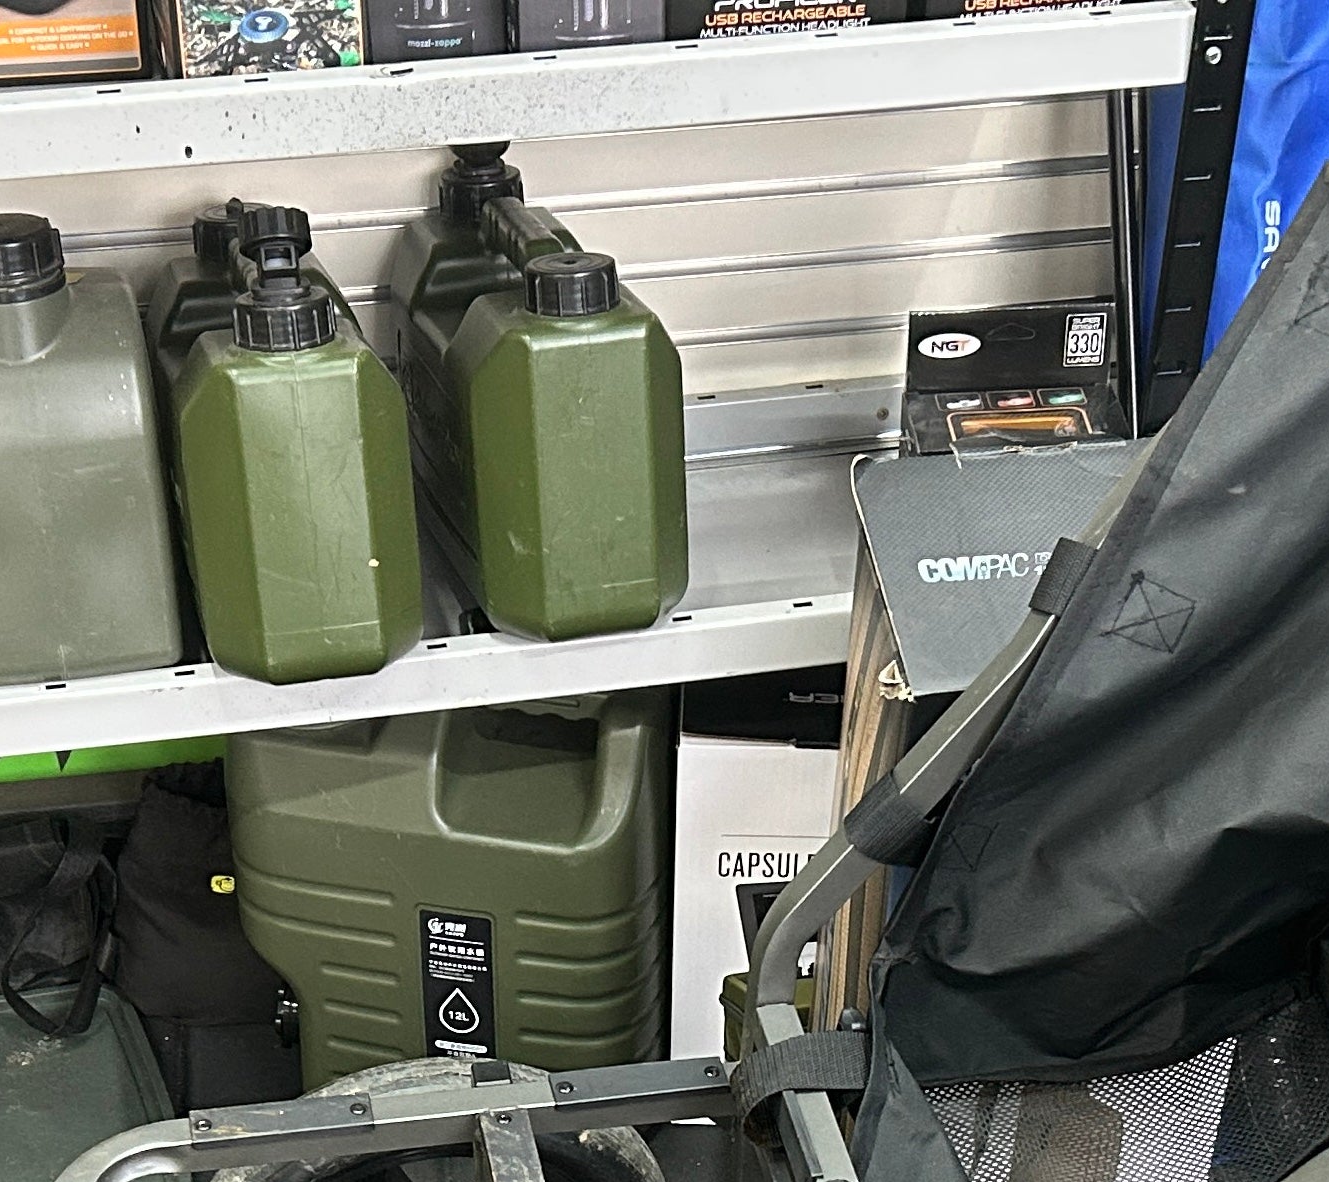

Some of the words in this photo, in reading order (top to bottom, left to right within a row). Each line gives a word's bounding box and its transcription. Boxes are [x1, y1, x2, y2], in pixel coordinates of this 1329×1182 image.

[705, 12, 738, 26] USB
[741, 5, 866, 25] RECHARGEABLE
[802, 17, 871, 32] HEADLIGHT
[930, 339, 971, 354] NGT
[1070, 333, 1099, 354] 330
[448, 1010, 470, 1022] 12L
